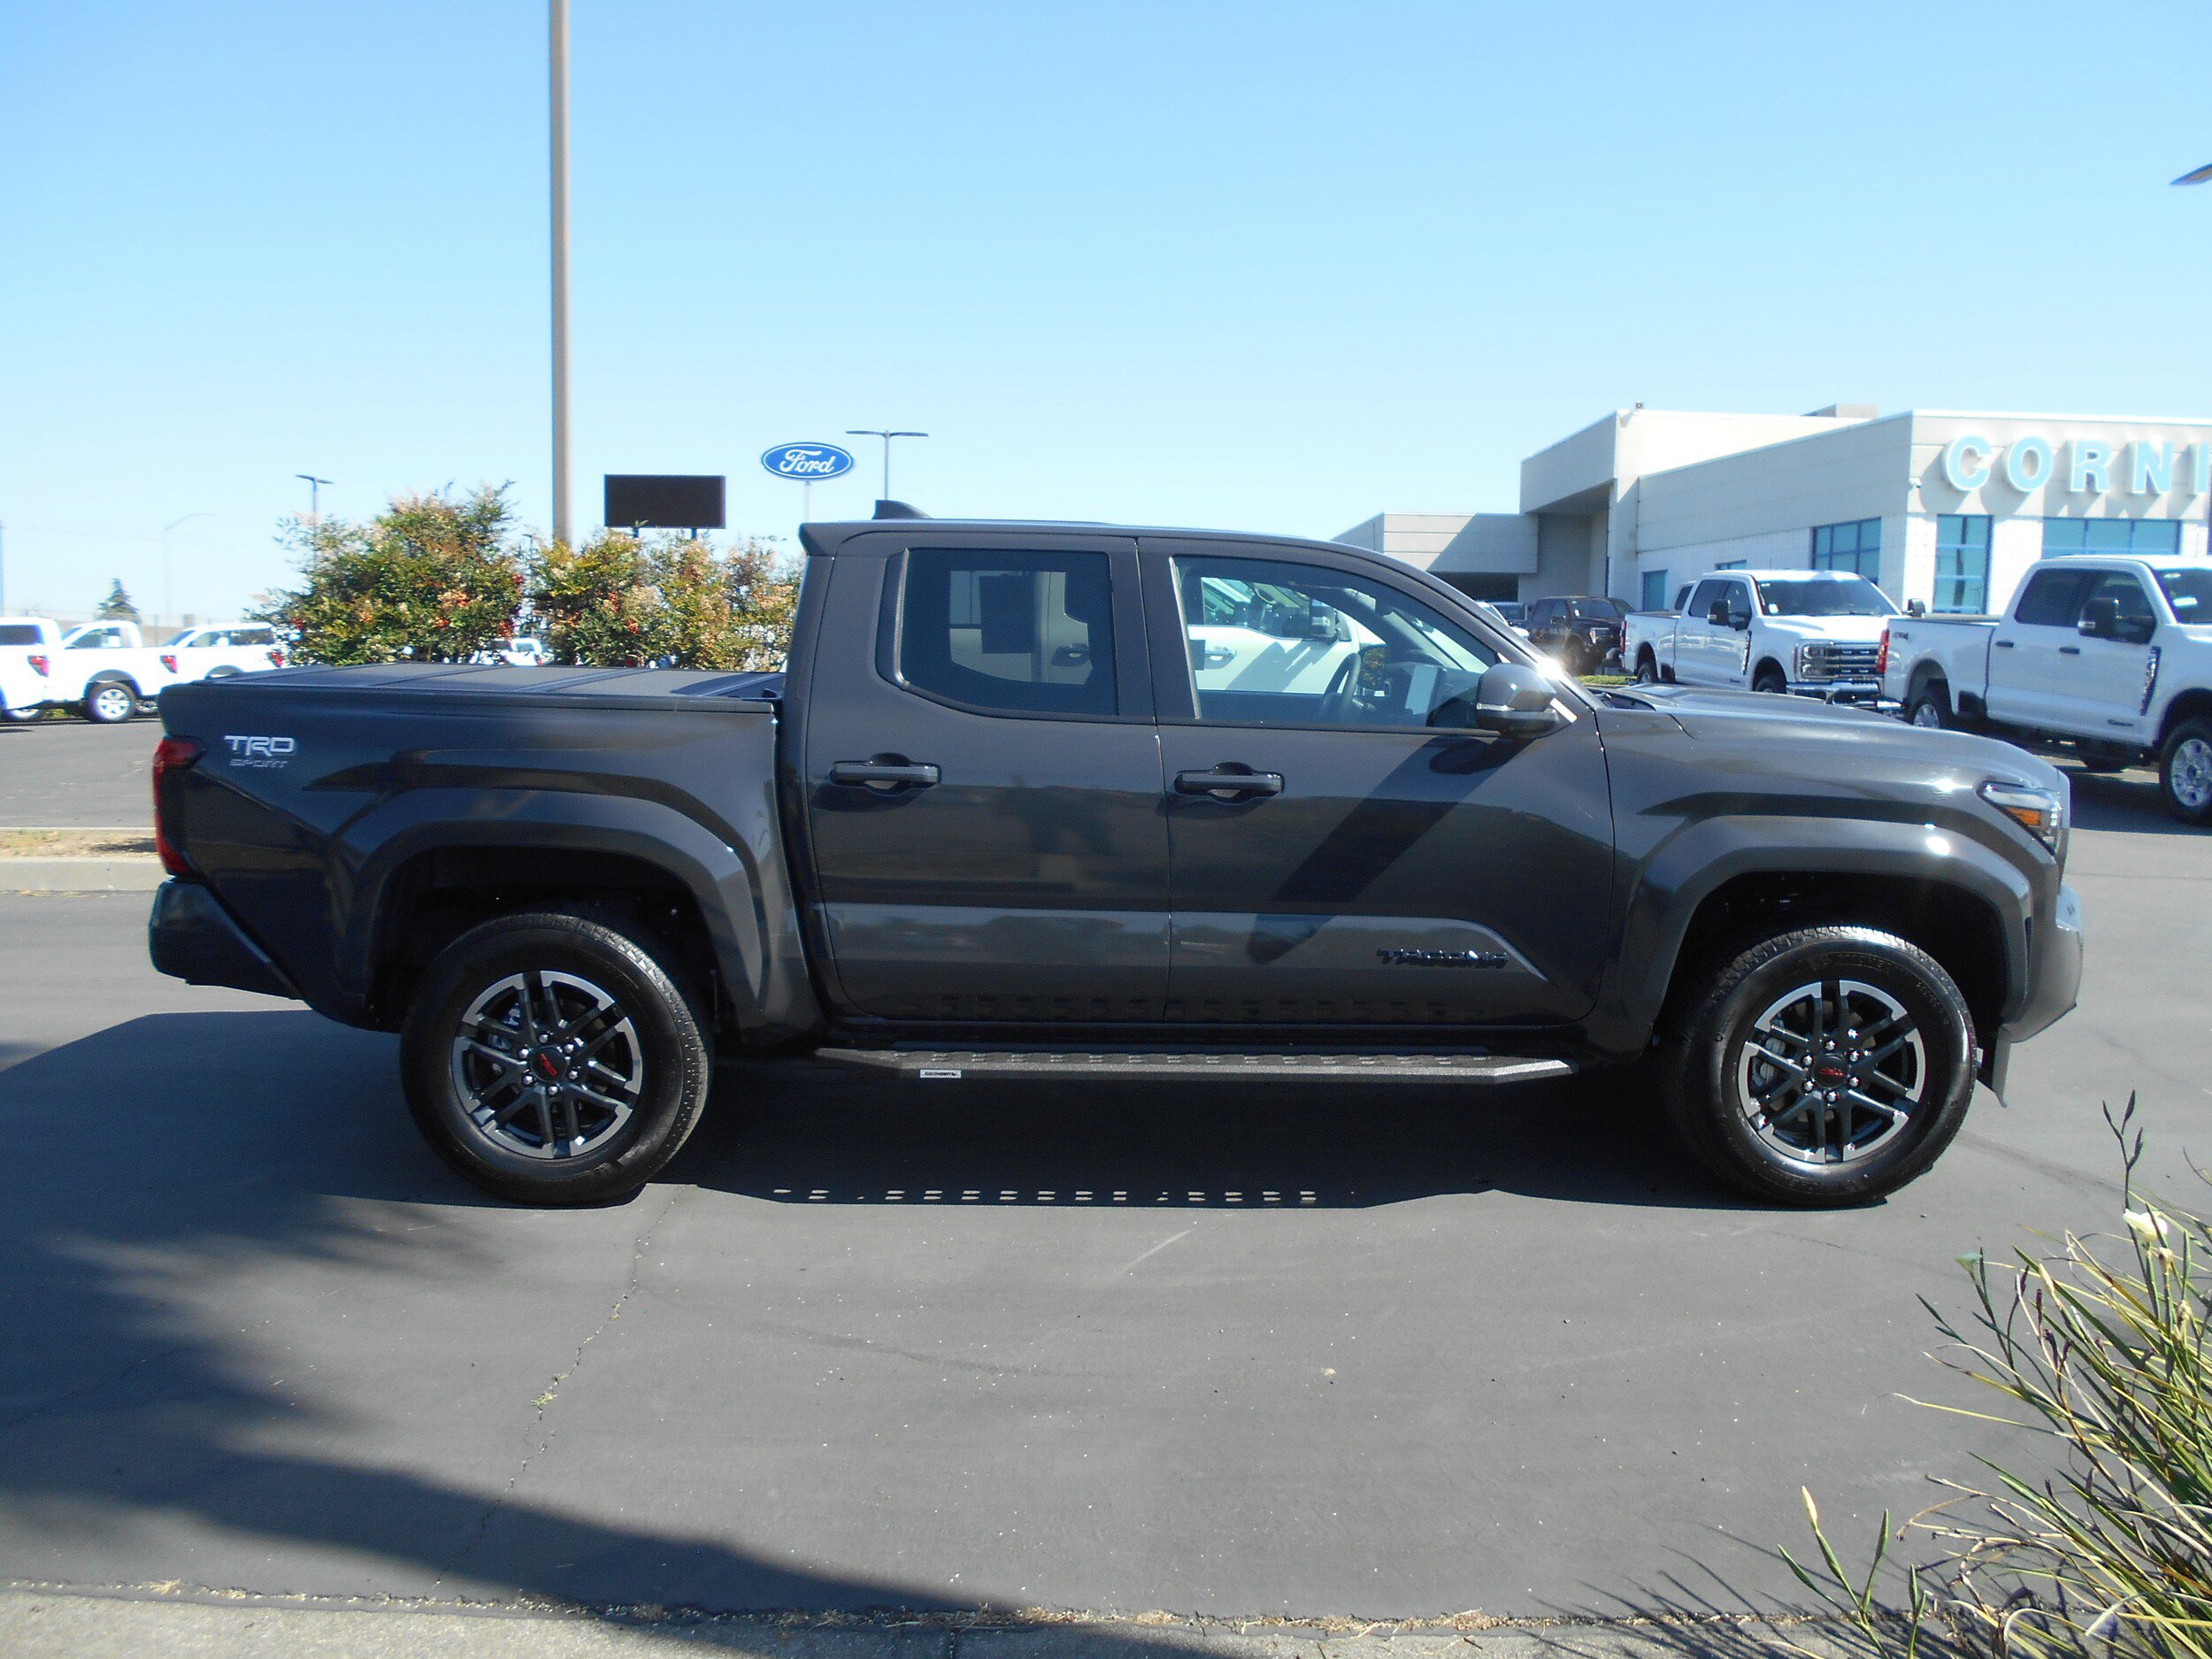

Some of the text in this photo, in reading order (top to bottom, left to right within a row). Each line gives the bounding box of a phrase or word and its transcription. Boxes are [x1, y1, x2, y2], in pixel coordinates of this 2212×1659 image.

[780, 449, 836, 472] Ford
[1944, 434, 2210, 495] CORNI
[224, 735, 295, 757] TRD
[230, 758, 288, 768] SPORT
